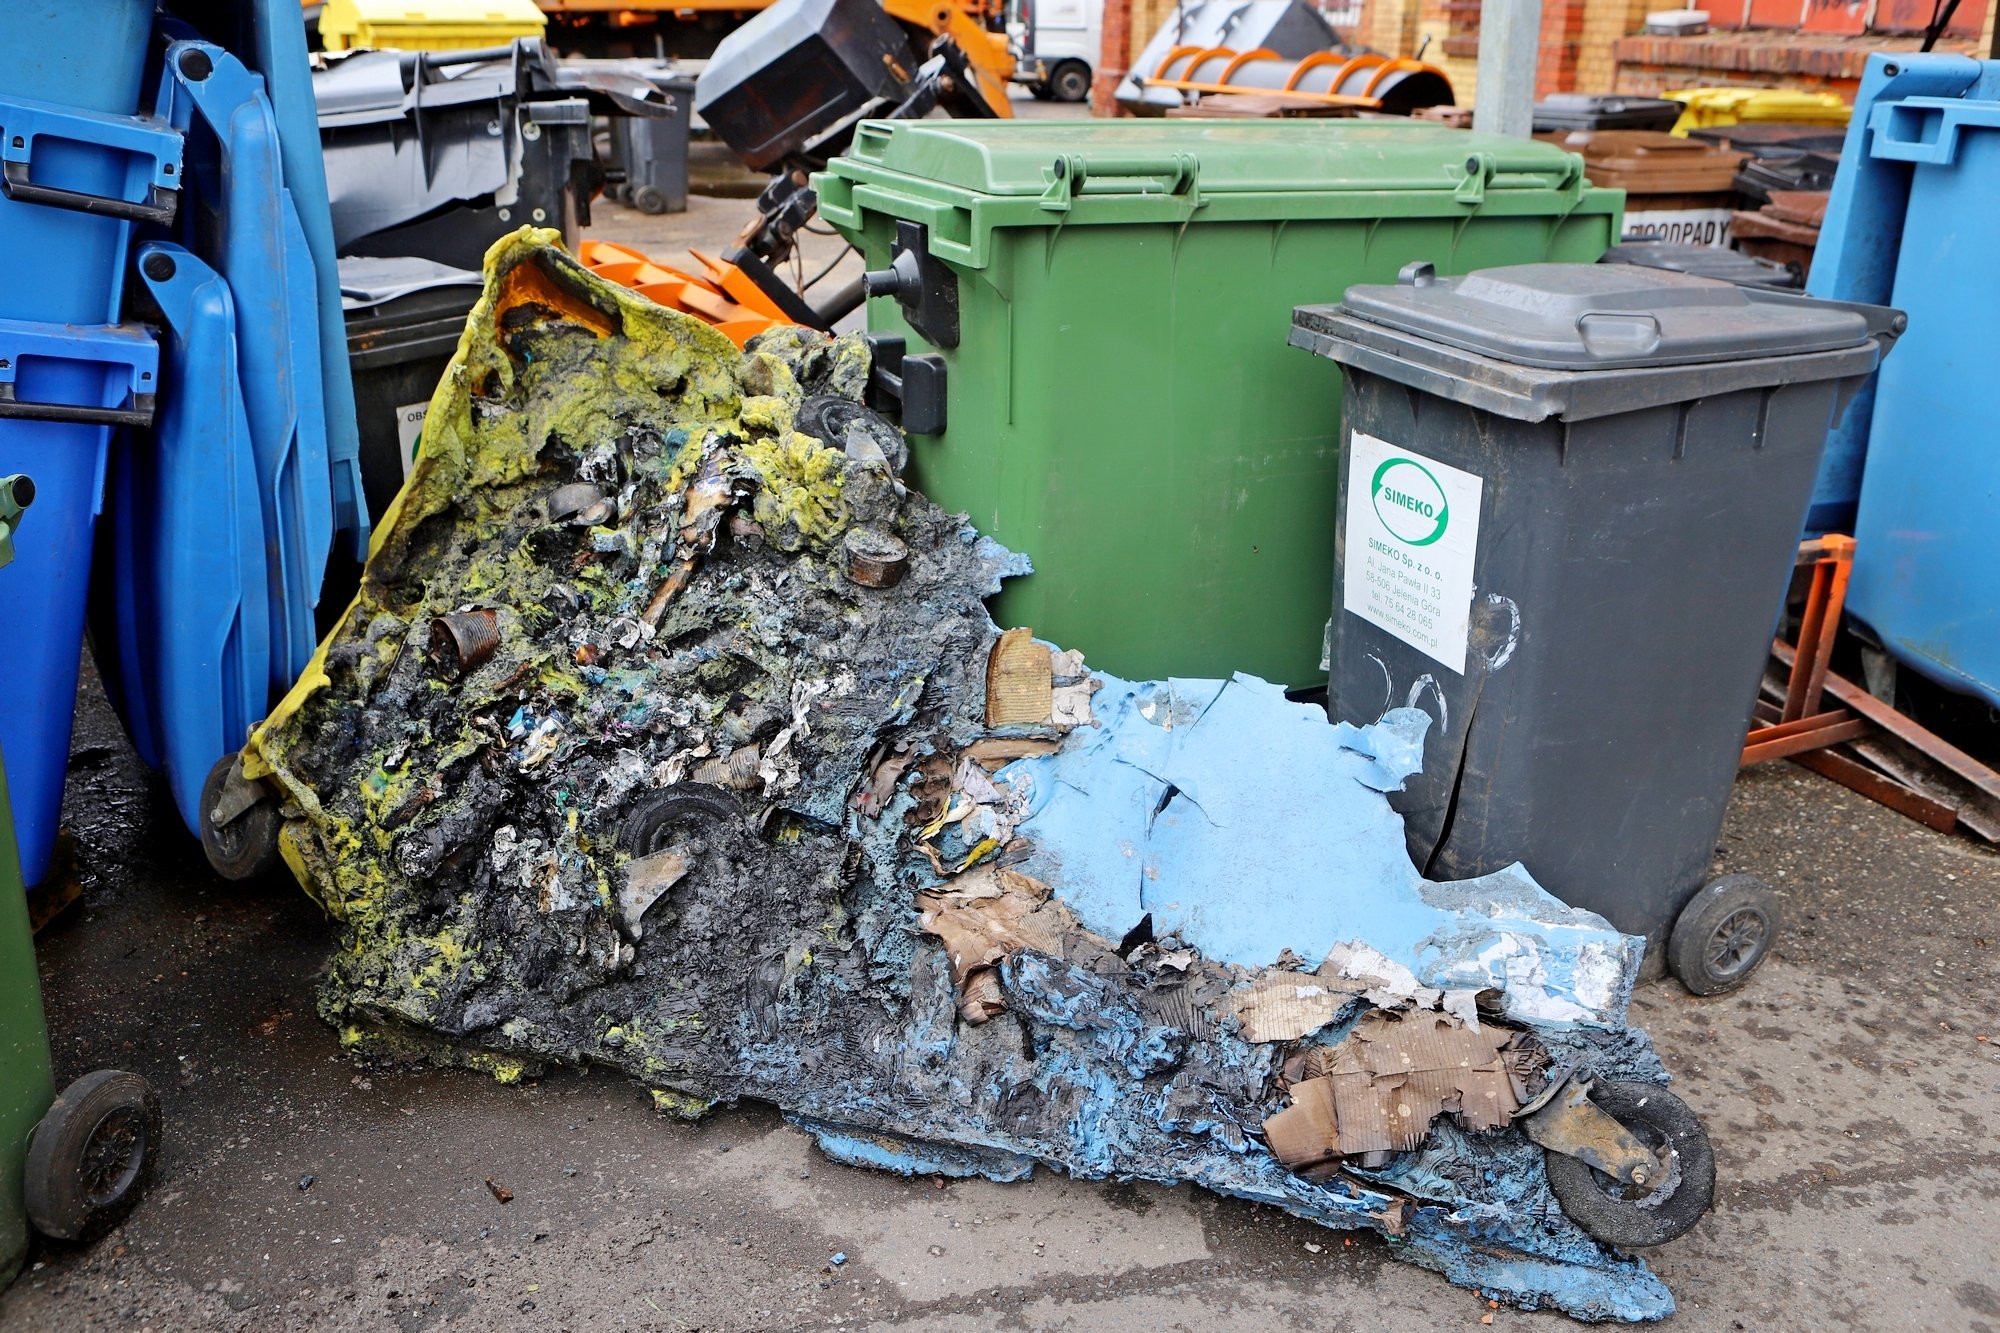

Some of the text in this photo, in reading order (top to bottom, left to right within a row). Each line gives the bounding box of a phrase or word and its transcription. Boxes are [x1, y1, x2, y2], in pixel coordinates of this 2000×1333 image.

[1384, 486, 1434, 518] SIMEKO
[1368, 537, 1443, 582] SIMEKO Sp. z o. o.
[1377, 561, 1396, 579] Jana
[1397, 570, 1421, 591] Pawła
[1423, 583, 1429, 594] II
[1430, 586, 1441, 600] 33
[1366, 570, 1441, 617] 58-506 Jelenia Góra
[1384, 596, 1394, 609] 75
[1395, 601, 1405, 614] 64
[1406, 607, 1416, 621] 28
[1418, 613, 1433, 630] 065
[1367, 602, 1438, 649] www.simeko.com.pl
